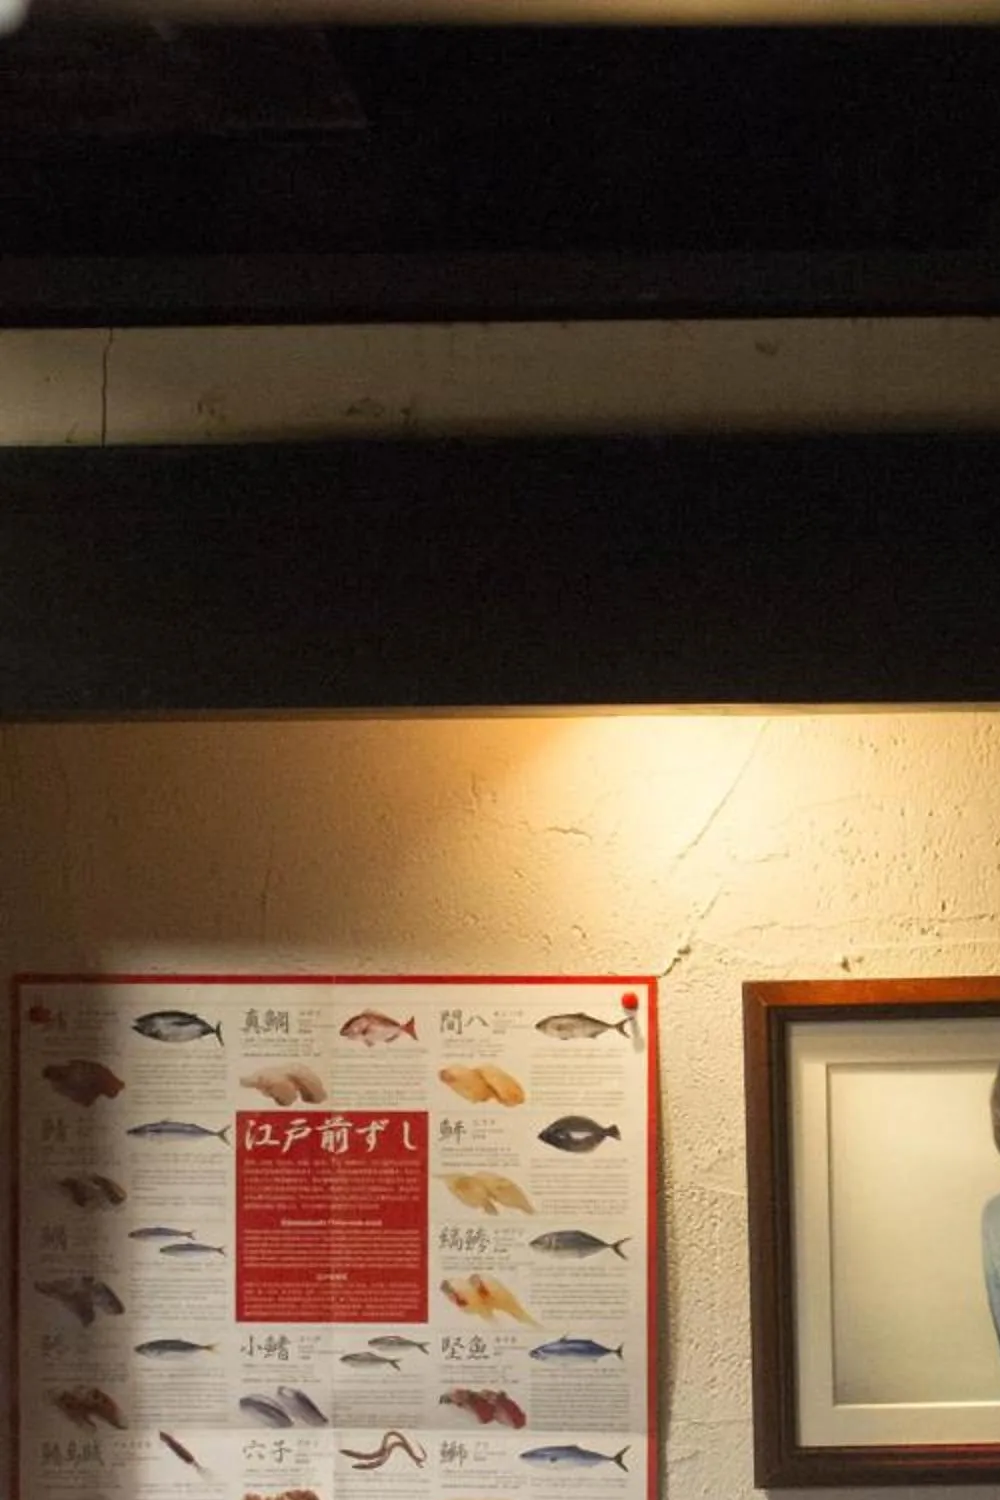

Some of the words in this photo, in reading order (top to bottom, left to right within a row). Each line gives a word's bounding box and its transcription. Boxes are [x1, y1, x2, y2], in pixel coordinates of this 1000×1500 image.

[244, 1116, 417, 1154] 江戸前ずし
[242, 1439, 293, 1464] 穴子
